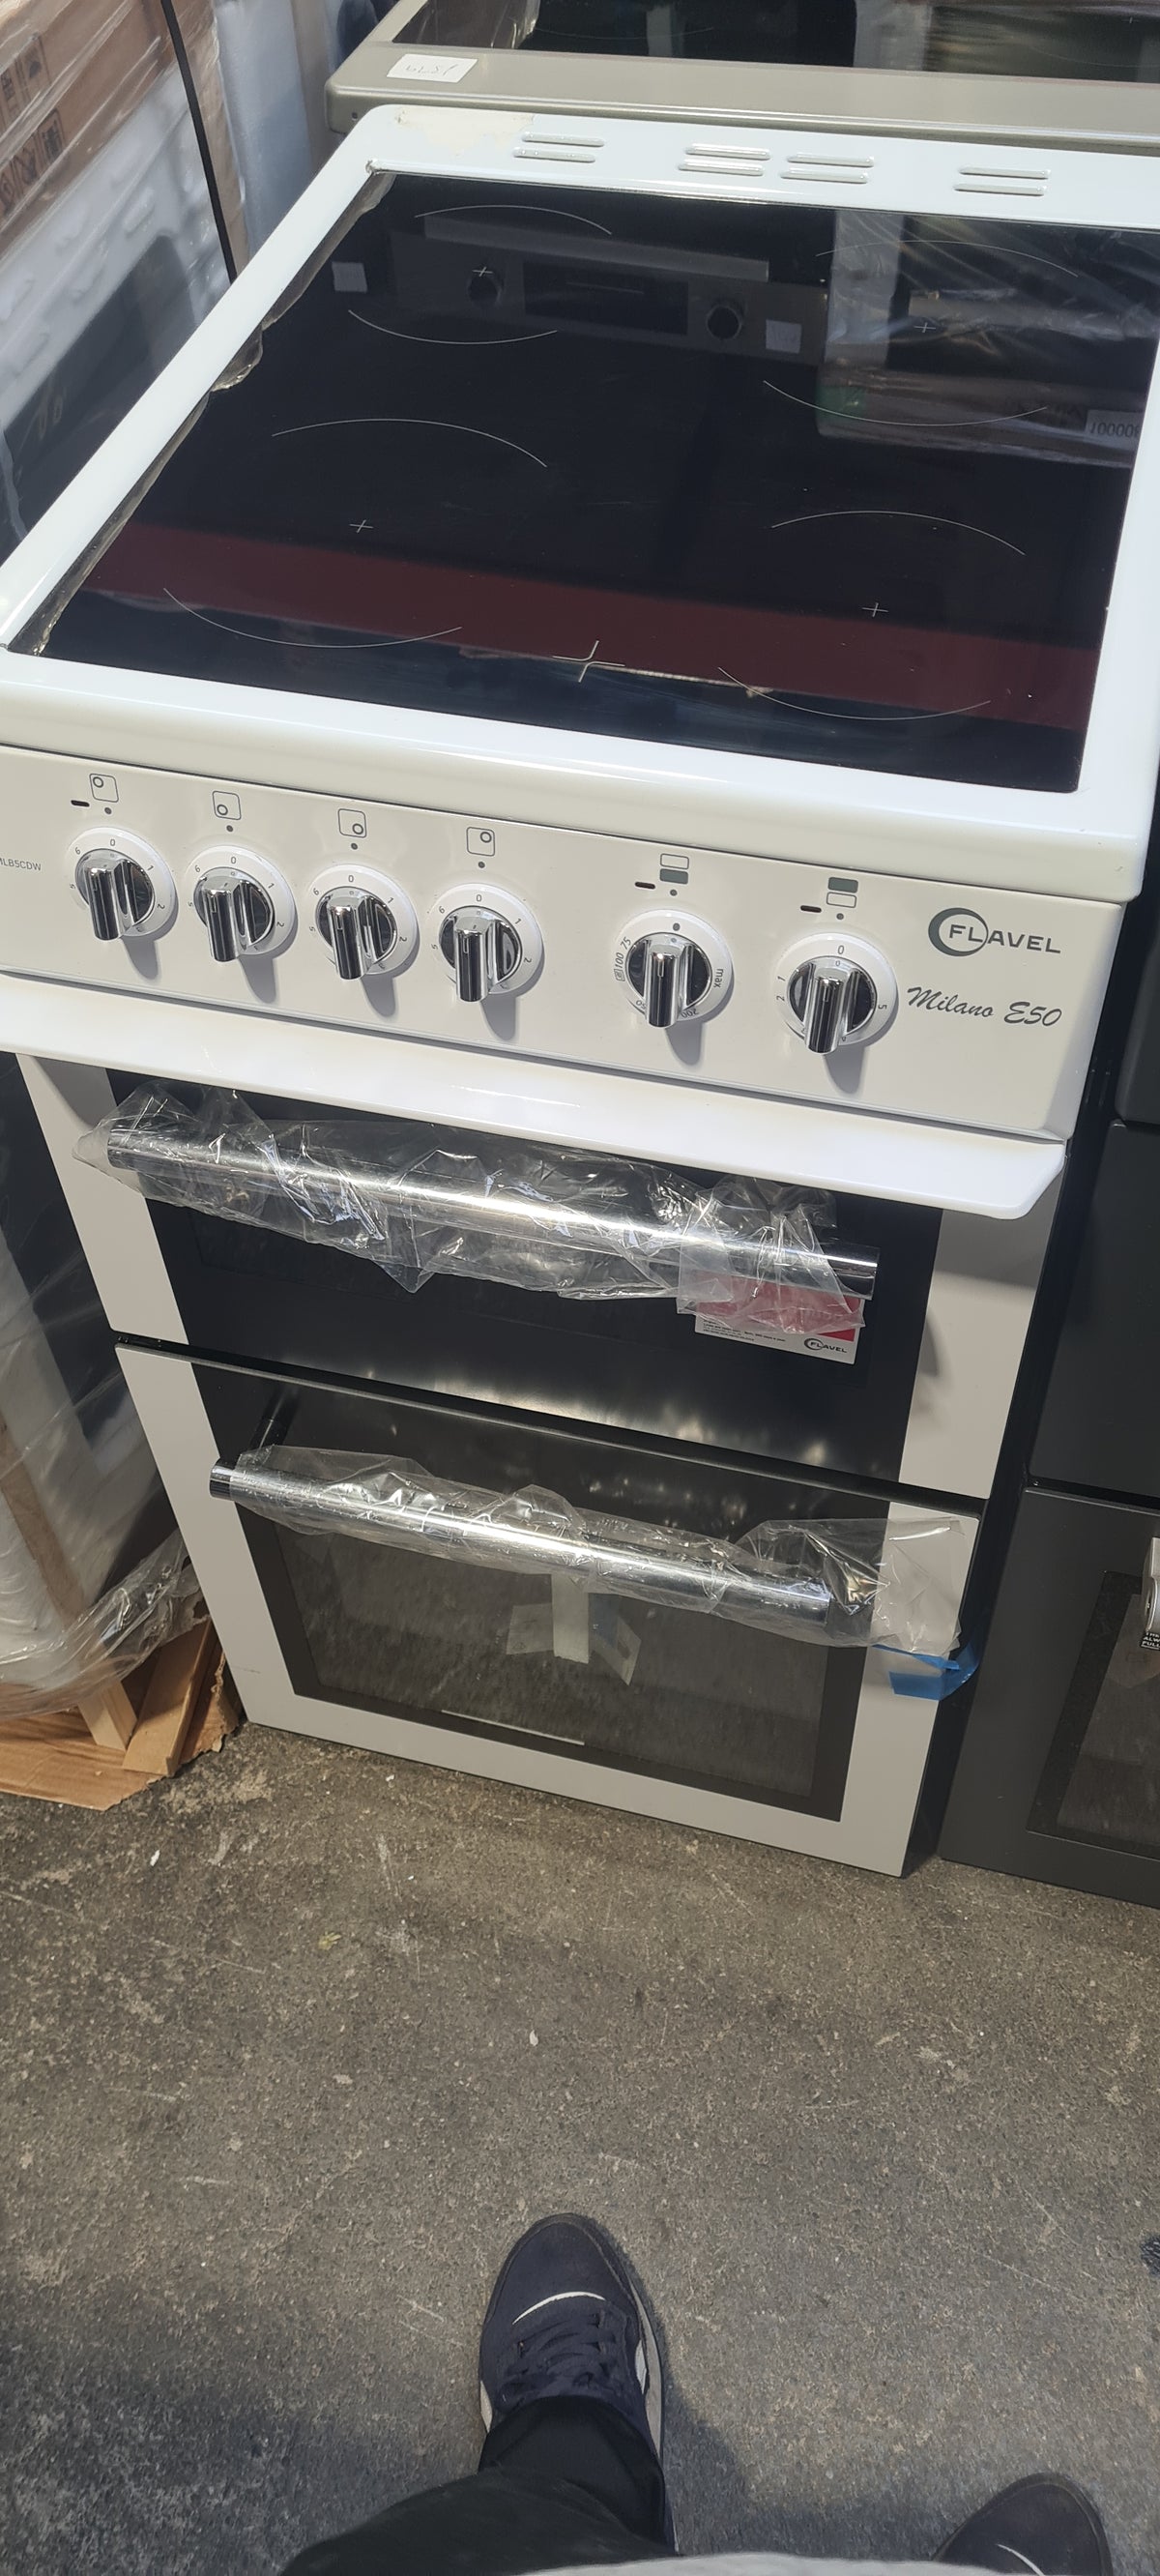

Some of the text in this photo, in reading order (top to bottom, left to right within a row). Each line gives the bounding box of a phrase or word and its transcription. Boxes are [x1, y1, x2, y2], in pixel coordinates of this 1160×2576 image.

[109, 838, 116, 847] 0
[230, 856, 237, 864] 0
[194, 864, 201, 873] 6
[348, 874, 355, 883] 0
[476, 893, 482, 902] 0
[438, 905, 446, 914] 6
[620, 936, 631, 950] 75
[949, 923, 1061, 954] FLAVEL
[837, 945, 845, 954] 0
[615, 951, 624, 968] 100
[713, 968, 724, 988] max
[907, 986, 1062, 1027] Milano E50
[810, 1341, 848, 1354] FLAVEL
